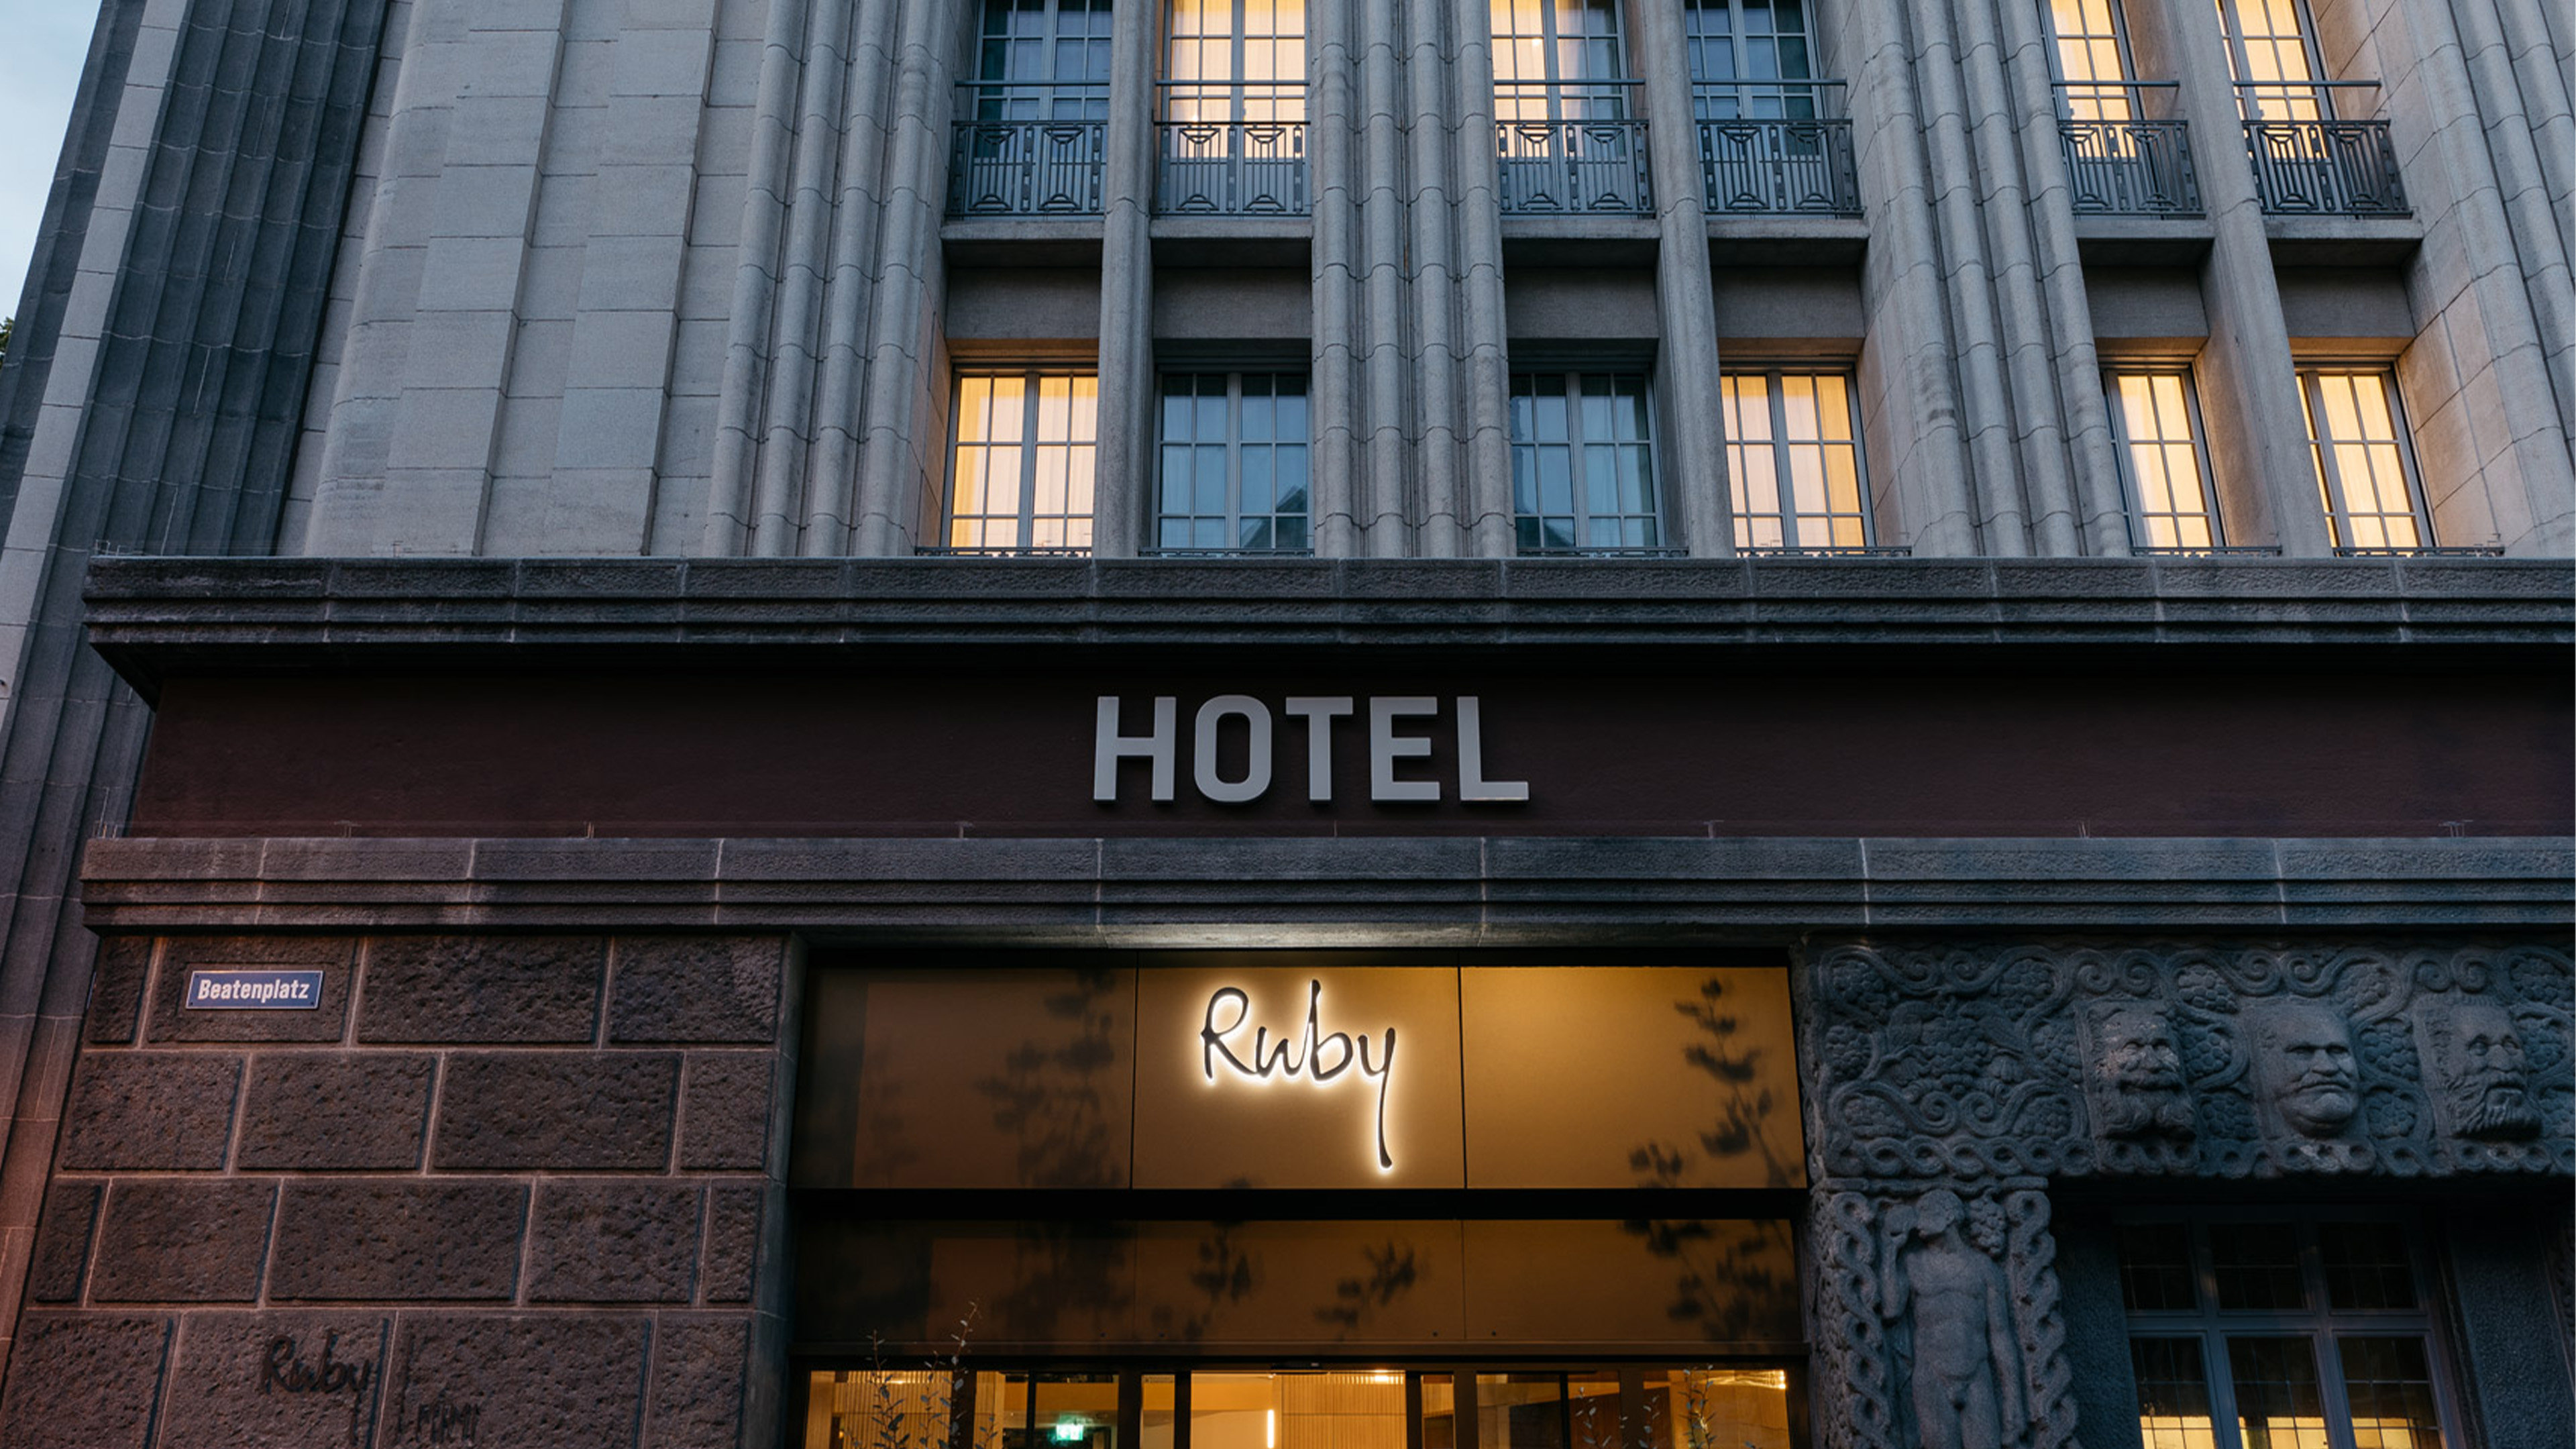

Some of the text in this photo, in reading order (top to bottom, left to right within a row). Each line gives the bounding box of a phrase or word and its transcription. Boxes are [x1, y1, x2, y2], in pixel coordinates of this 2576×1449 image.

[1093, 694, 1529, 802] HOTEL
[197, 979, 310, 1004] Beatenplatz
[1200, 979, 1396, 1169] Ruby
[262, 1328, 370, 1445] Ruby
